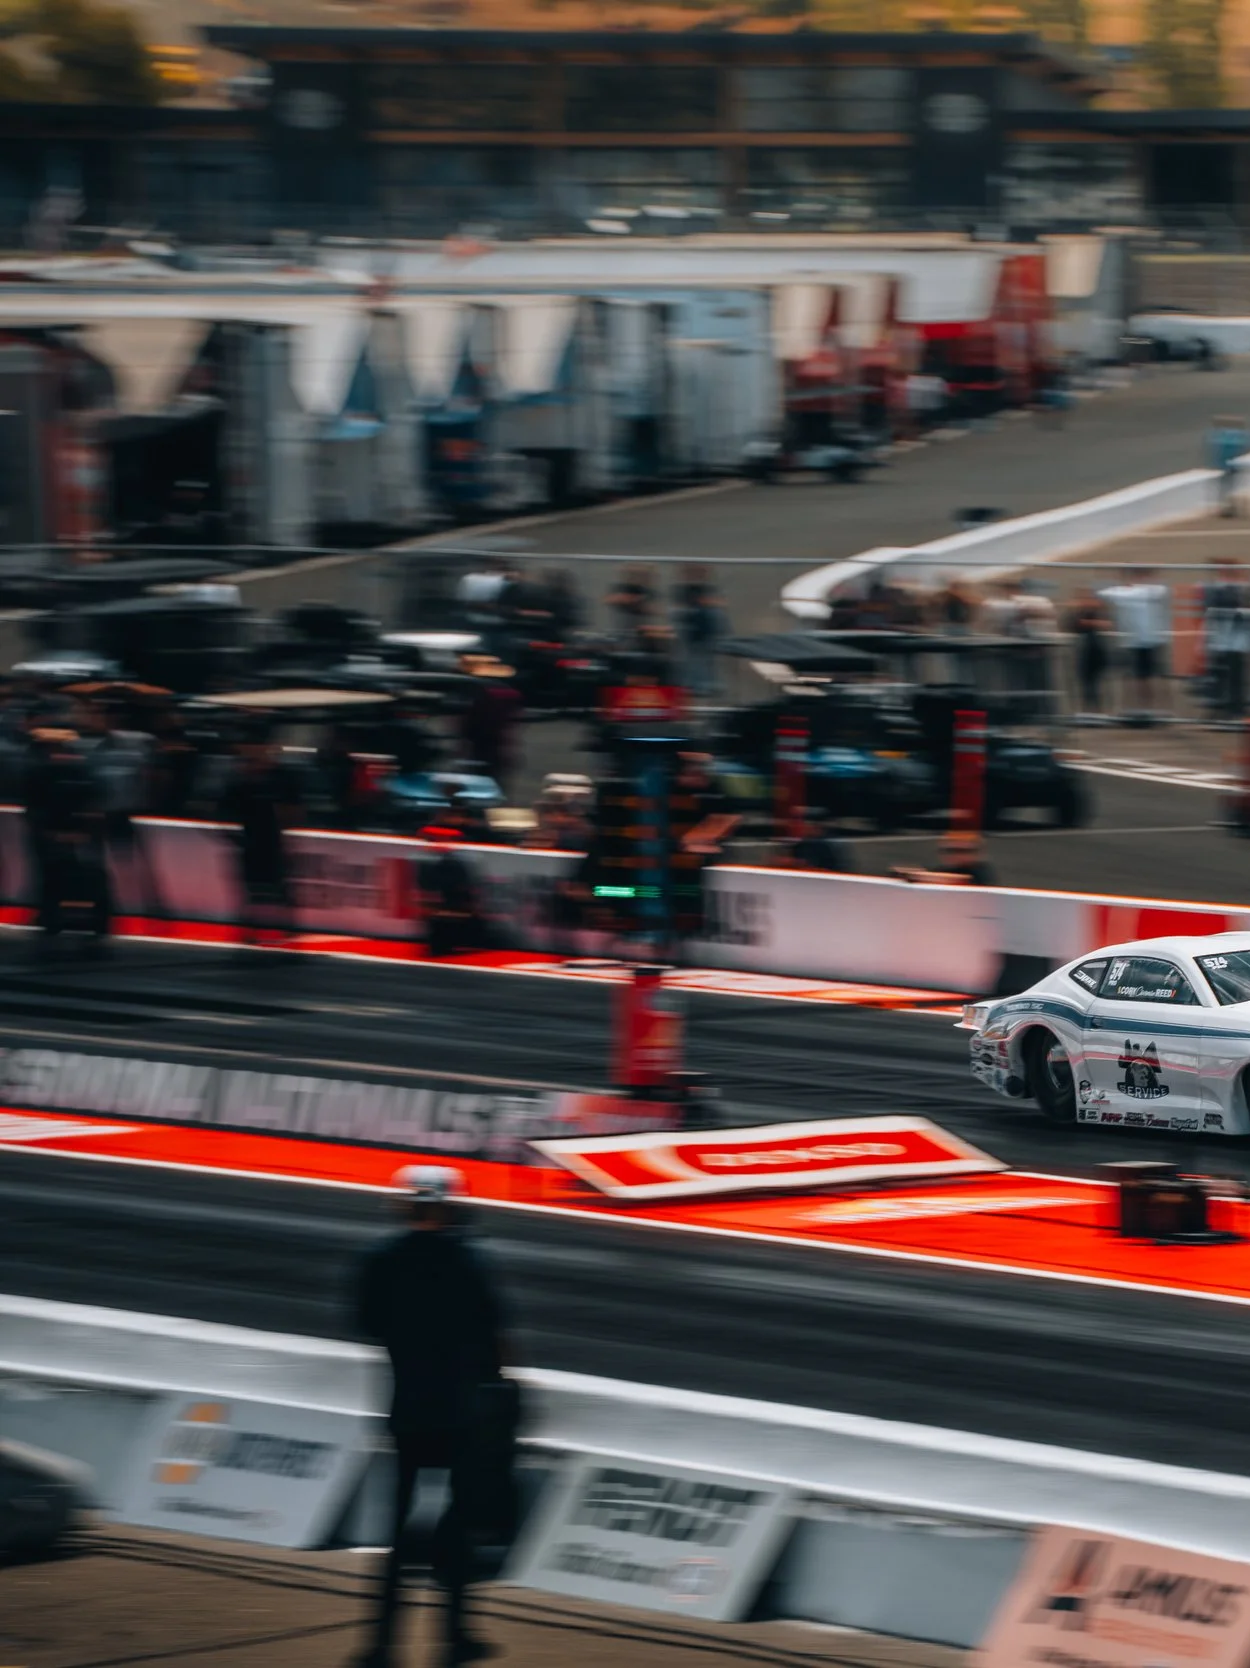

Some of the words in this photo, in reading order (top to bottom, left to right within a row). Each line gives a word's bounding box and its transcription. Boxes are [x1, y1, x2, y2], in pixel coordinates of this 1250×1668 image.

[1203, 957, 1228, 968] 574
[1155, 988, 1172, 998] REED
[1119, 1084, 1168, 1099] SERVICE
